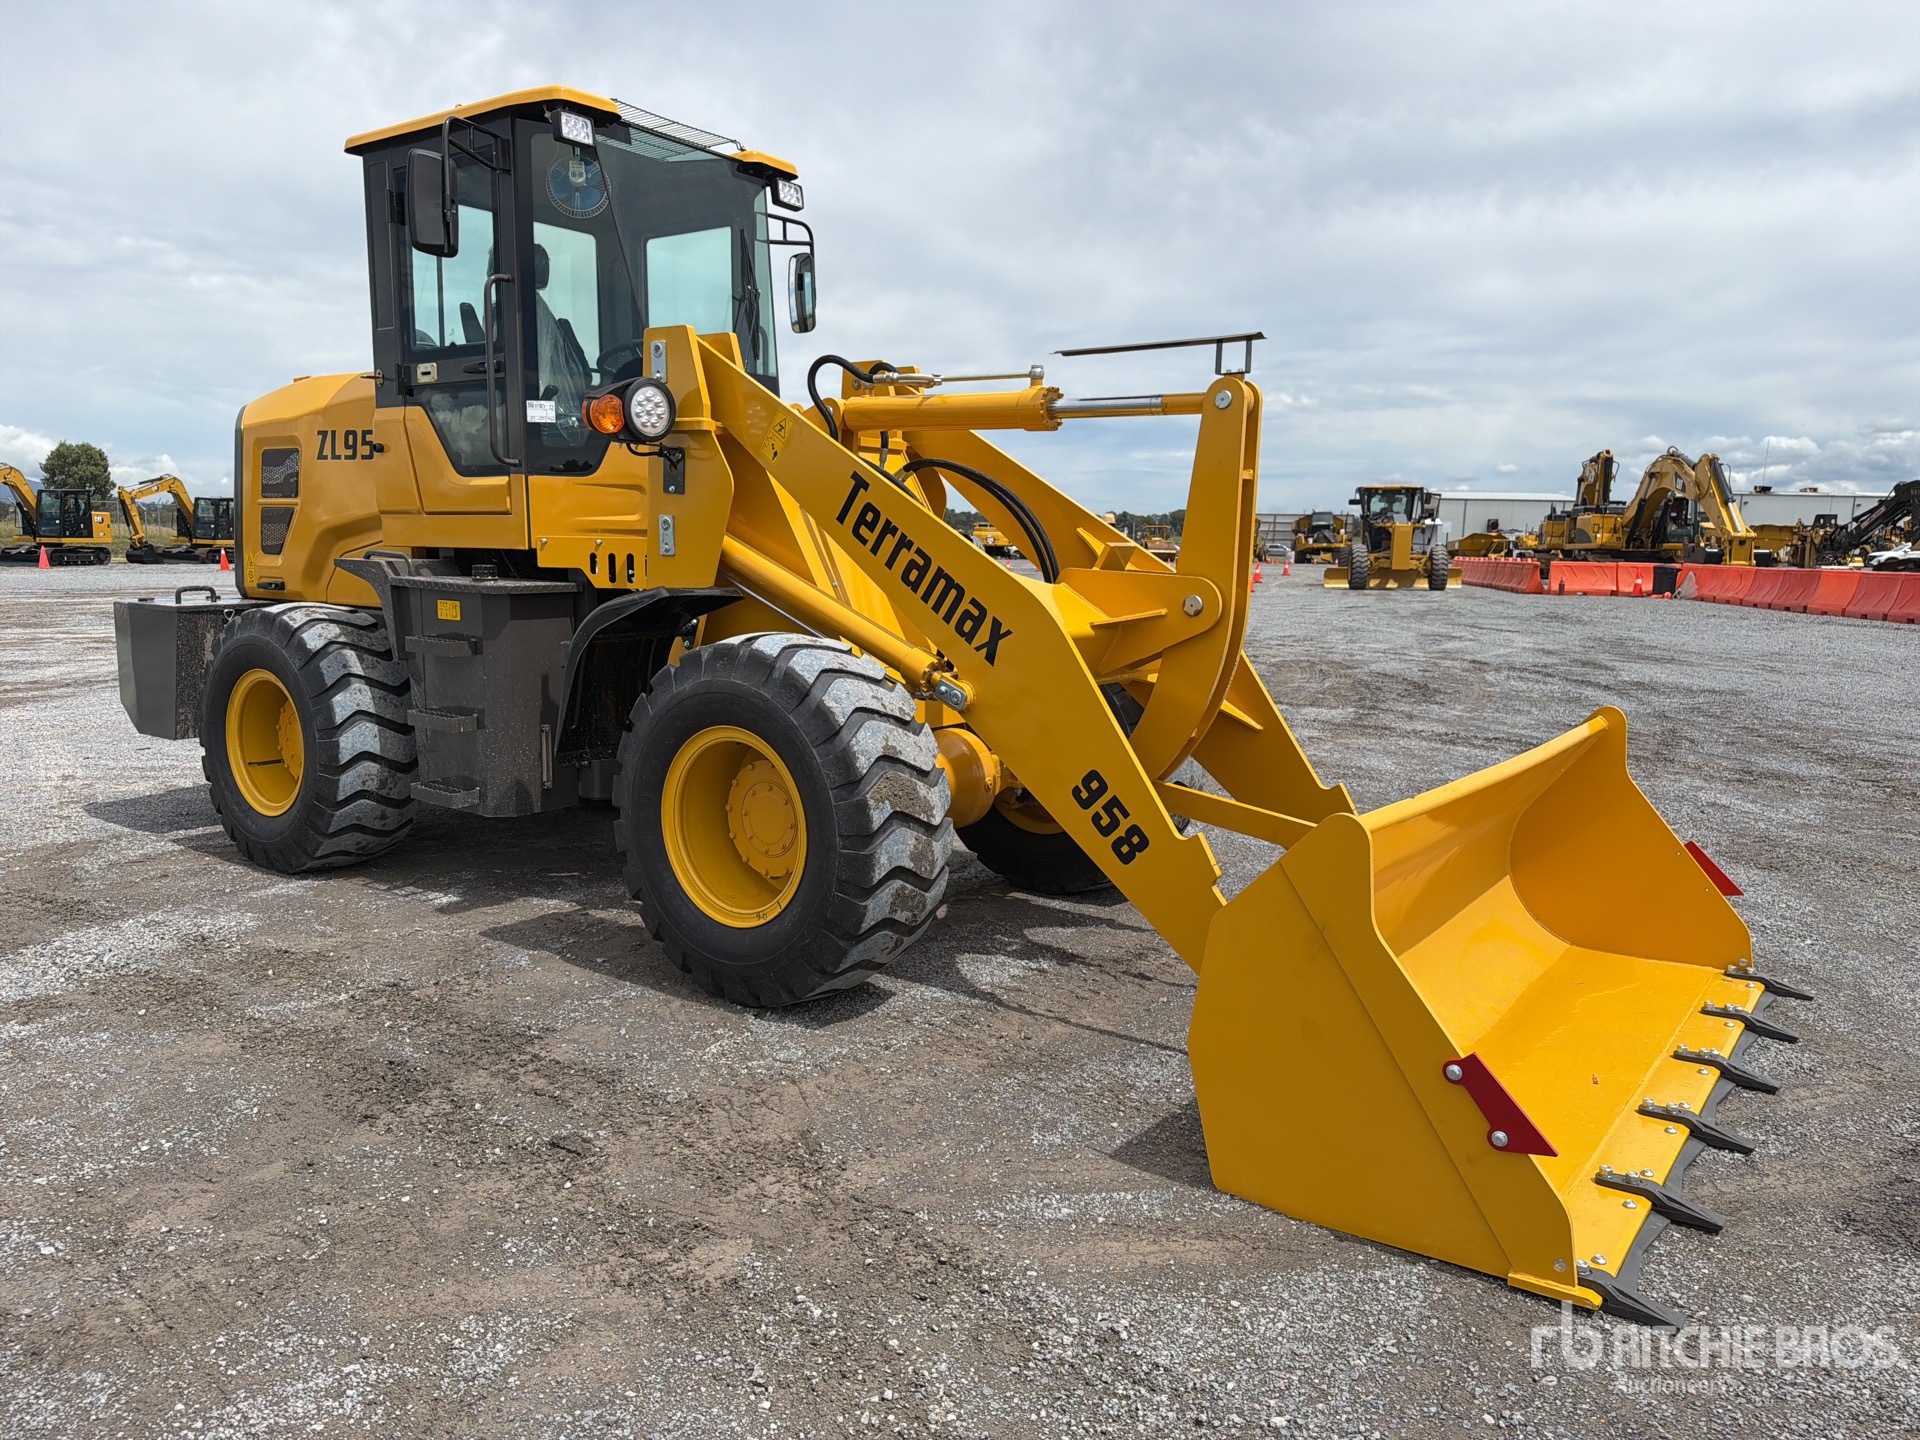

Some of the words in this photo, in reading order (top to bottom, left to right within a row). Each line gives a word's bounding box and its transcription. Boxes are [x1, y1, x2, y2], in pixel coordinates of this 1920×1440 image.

[316, 429, 375, 461] ZL95
[835, 470, 1013, 667] Terramax
[1071, 768, 1150, 866] 958
